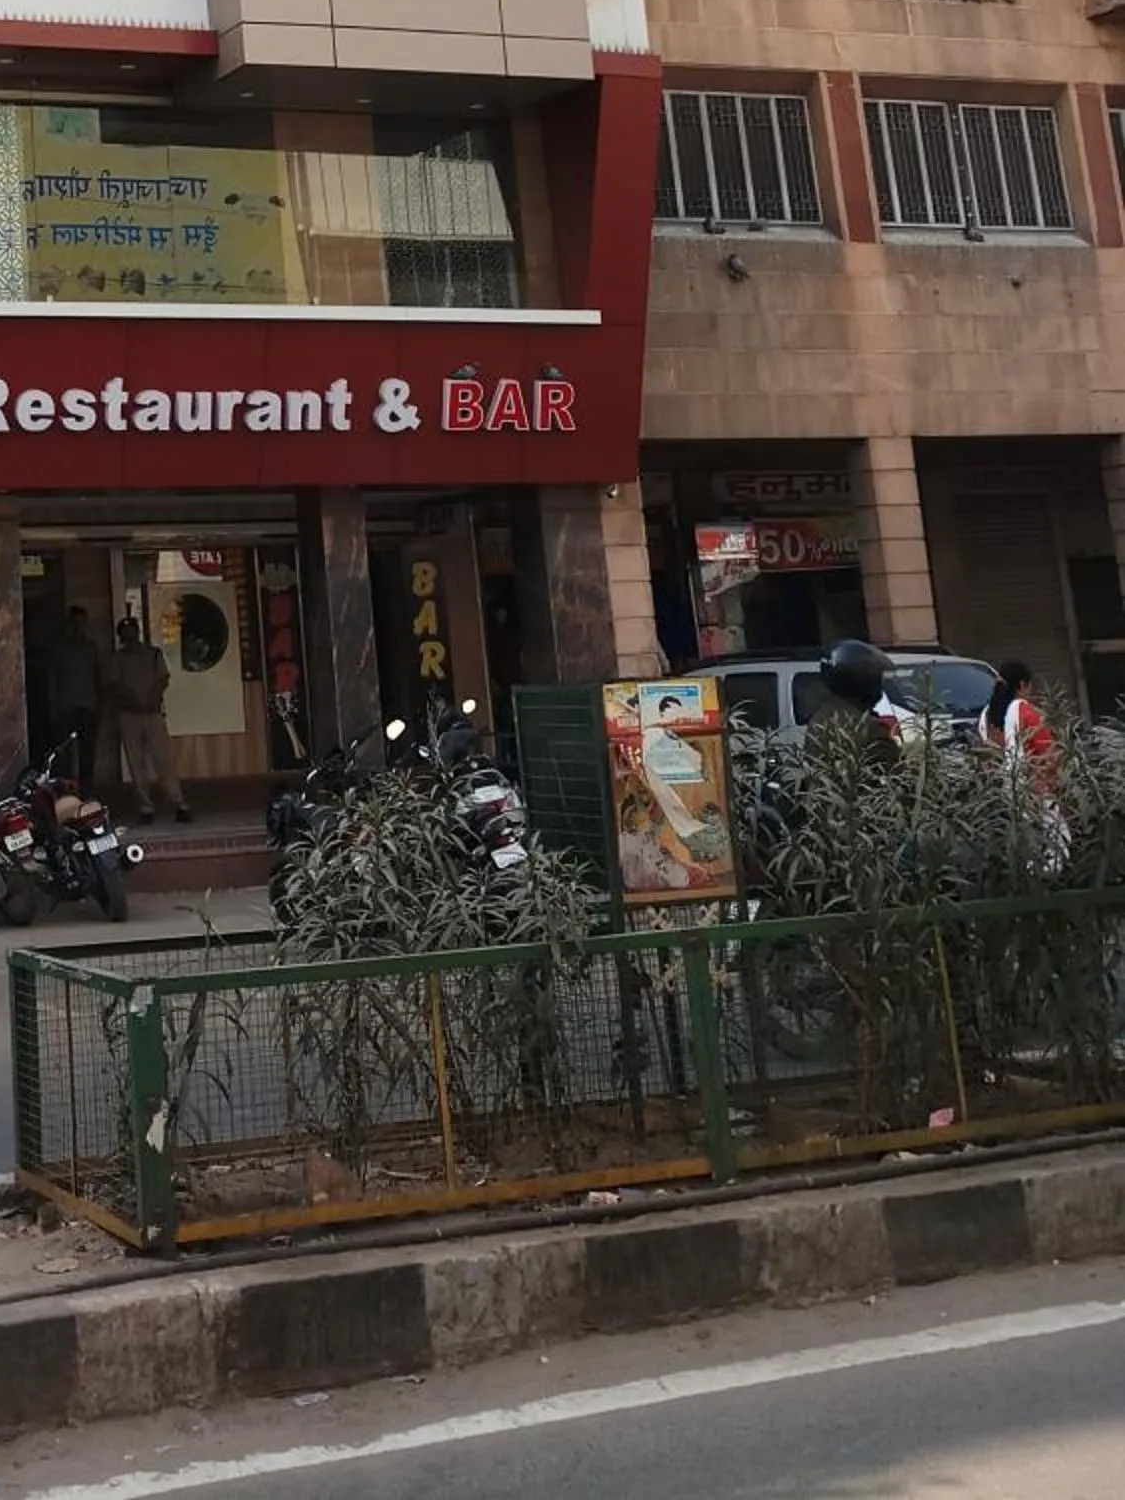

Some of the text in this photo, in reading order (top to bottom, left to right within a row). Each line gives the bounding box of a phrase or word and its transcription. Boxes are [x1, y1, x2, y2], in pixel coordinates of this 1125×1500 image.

[374, 377, 423, 433] &
[441, 379, 576, 431] BAR
[411, 560, 446, 680] BAR
